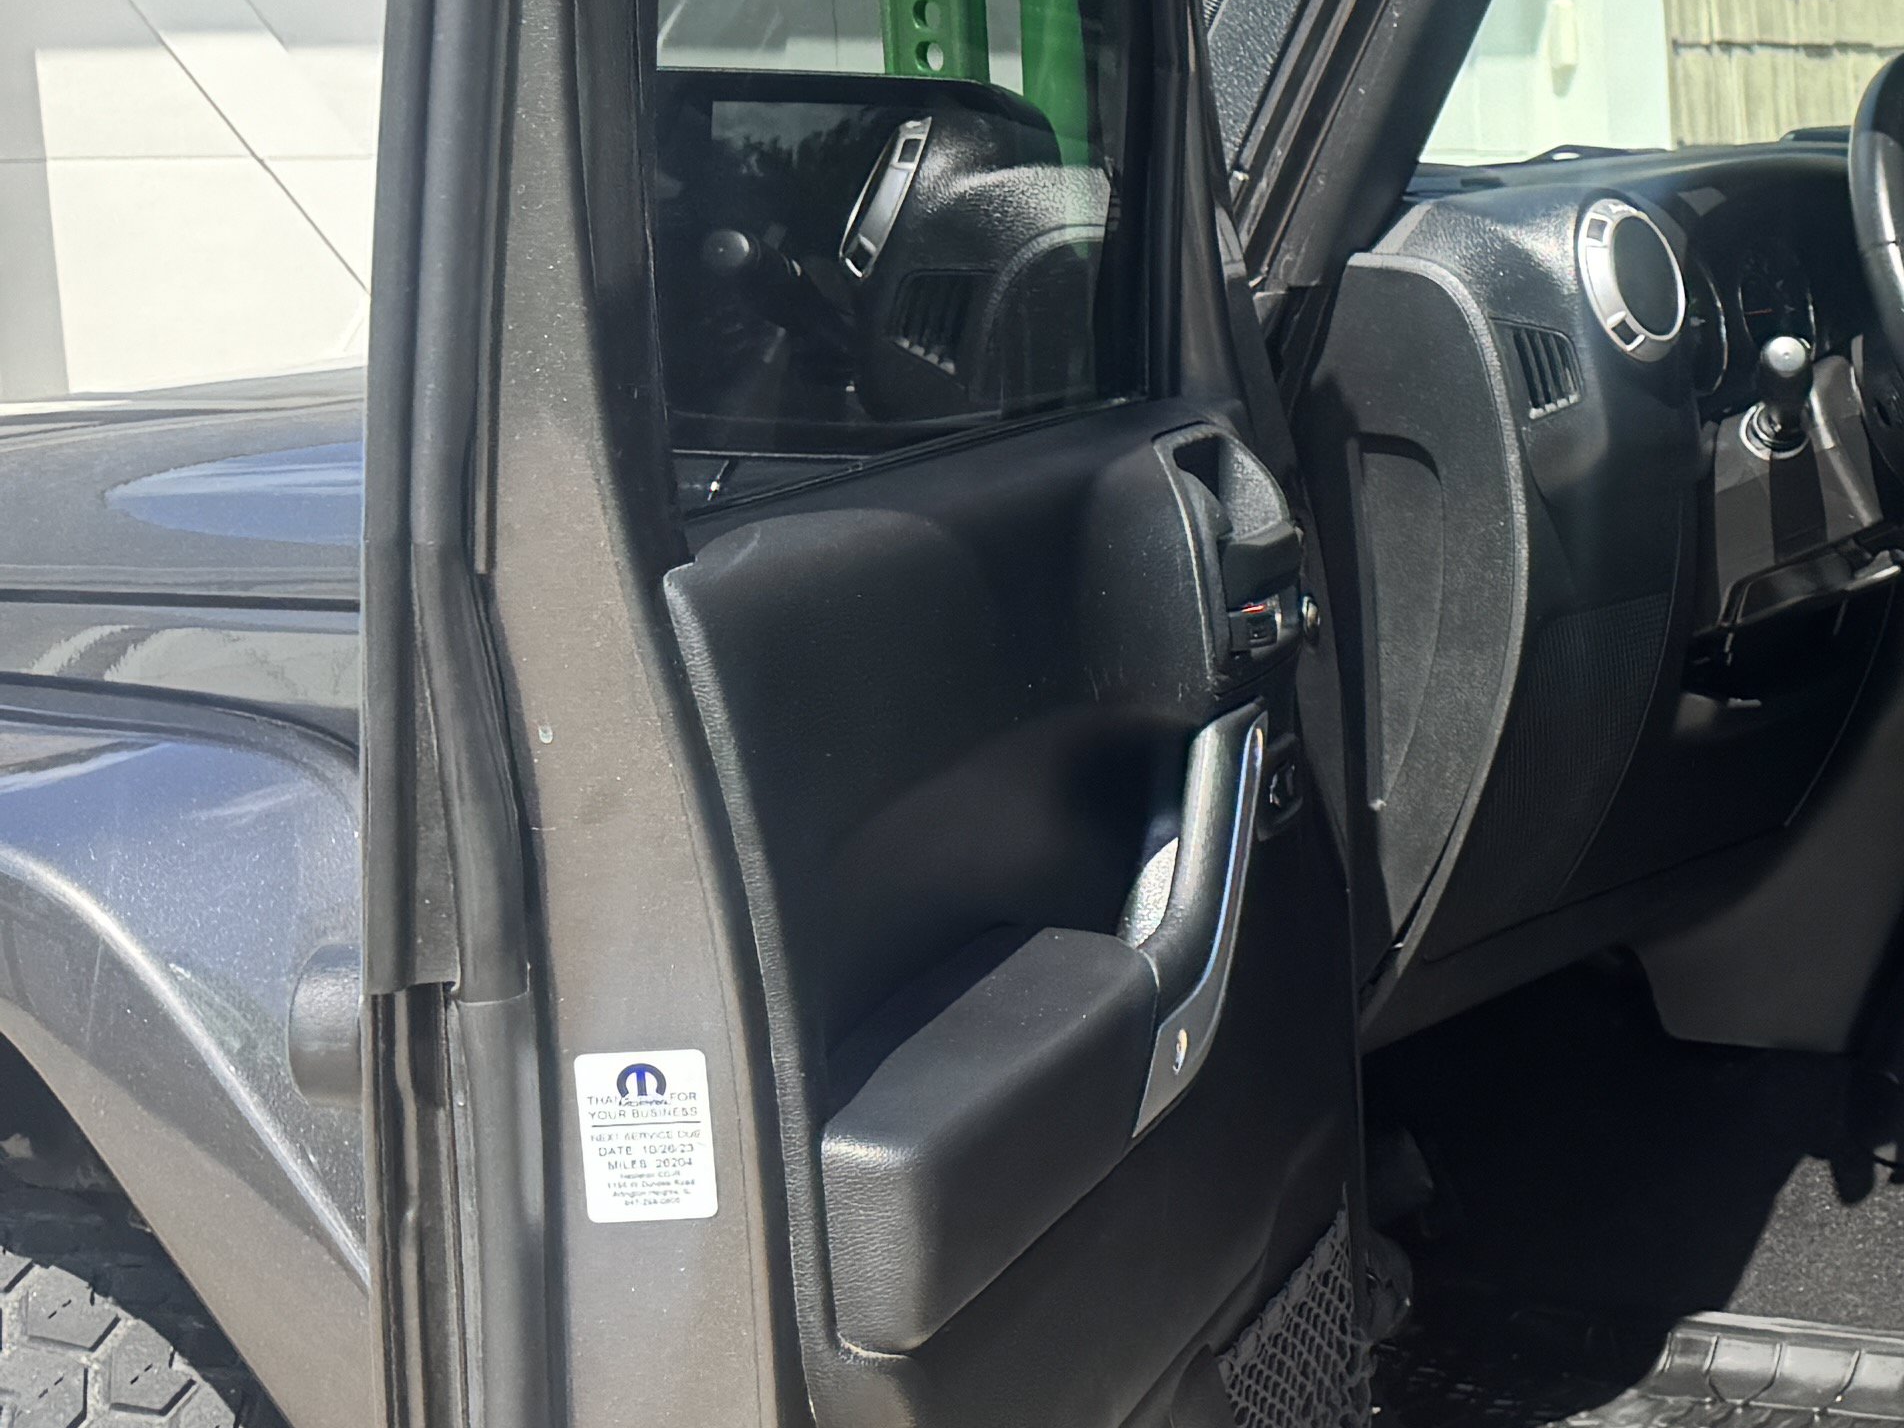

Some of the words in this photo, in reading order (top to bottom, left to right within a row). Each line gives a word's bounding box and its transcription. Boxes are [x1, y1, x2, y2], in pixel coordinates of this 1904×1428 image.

[669, 1092, 697, 1102] FOR
[588, 1109, 626, 1120] YOUR
[631, 1106, 698, 1118] BUSINESS
[598, 1145, 632, 1156] DATE
[607, 1159, 648, 1171] MILES
